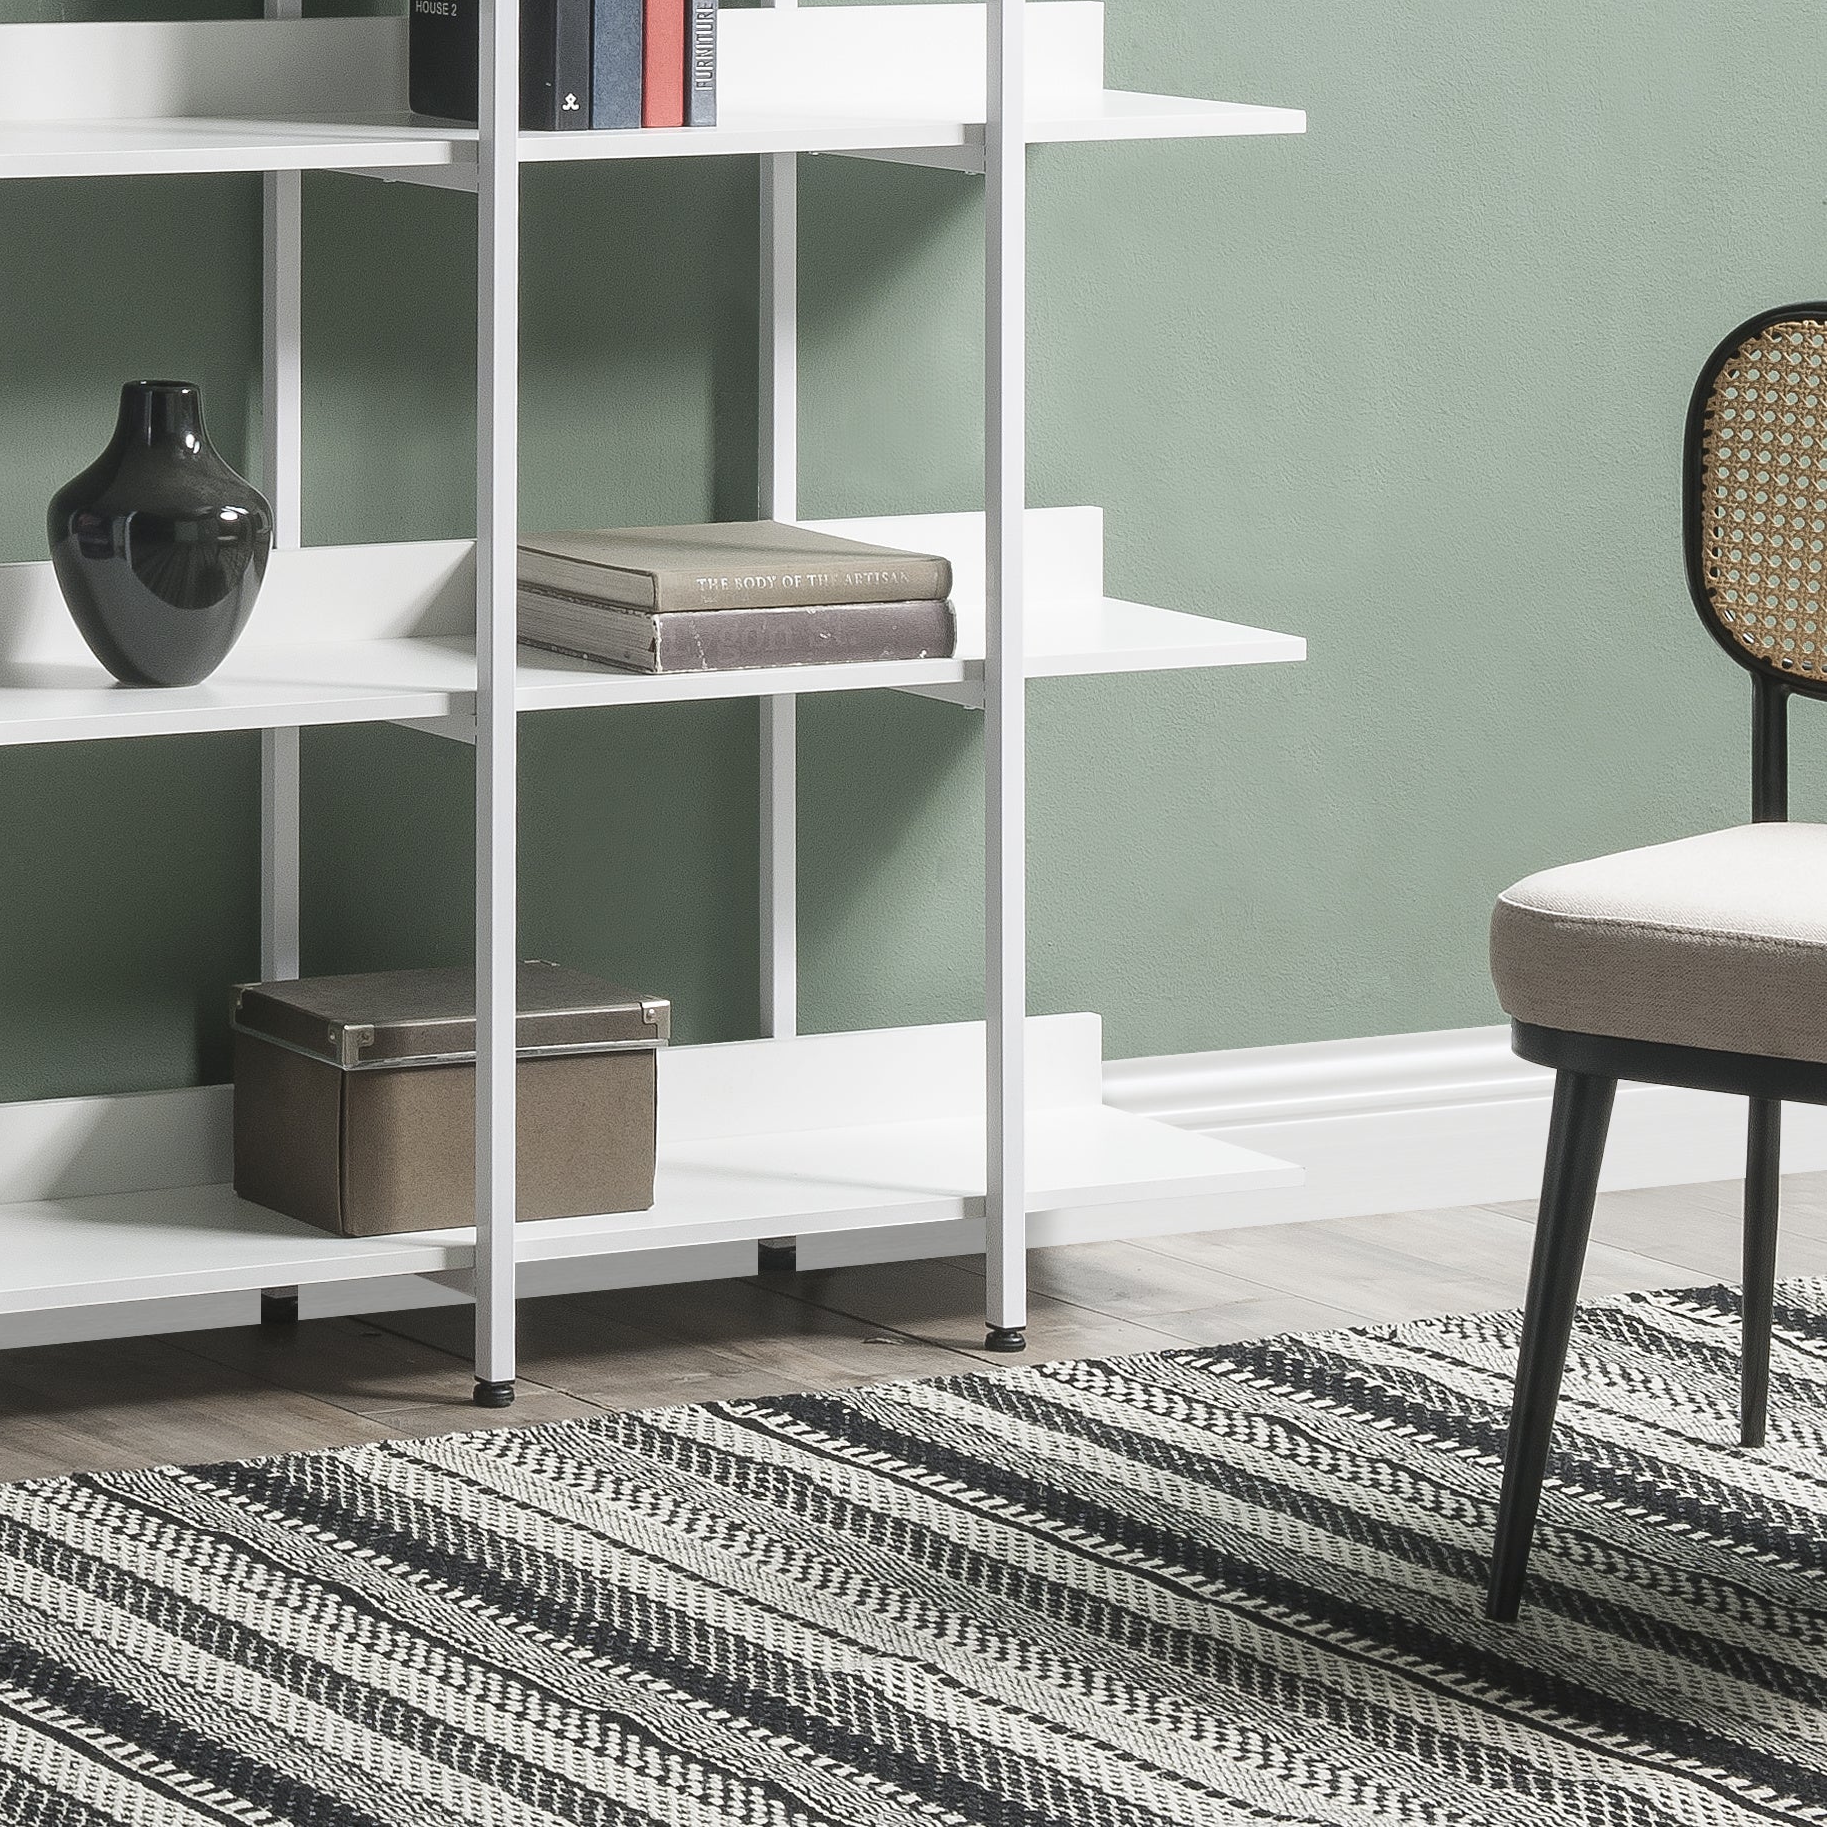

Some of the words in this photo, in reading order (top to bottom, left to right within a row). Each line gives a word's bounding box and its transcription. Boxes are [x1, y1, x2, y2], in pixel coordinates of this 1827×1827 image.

[416, 0, 449, 16] HOUSE
[451, 3, 458, 17] 2
[696, 3, 714, 91] FURNITURE
[697, 577, 728, 591] THE
[735, 575, 777, 591] BODY
[782, 575, 802, 588] OF
